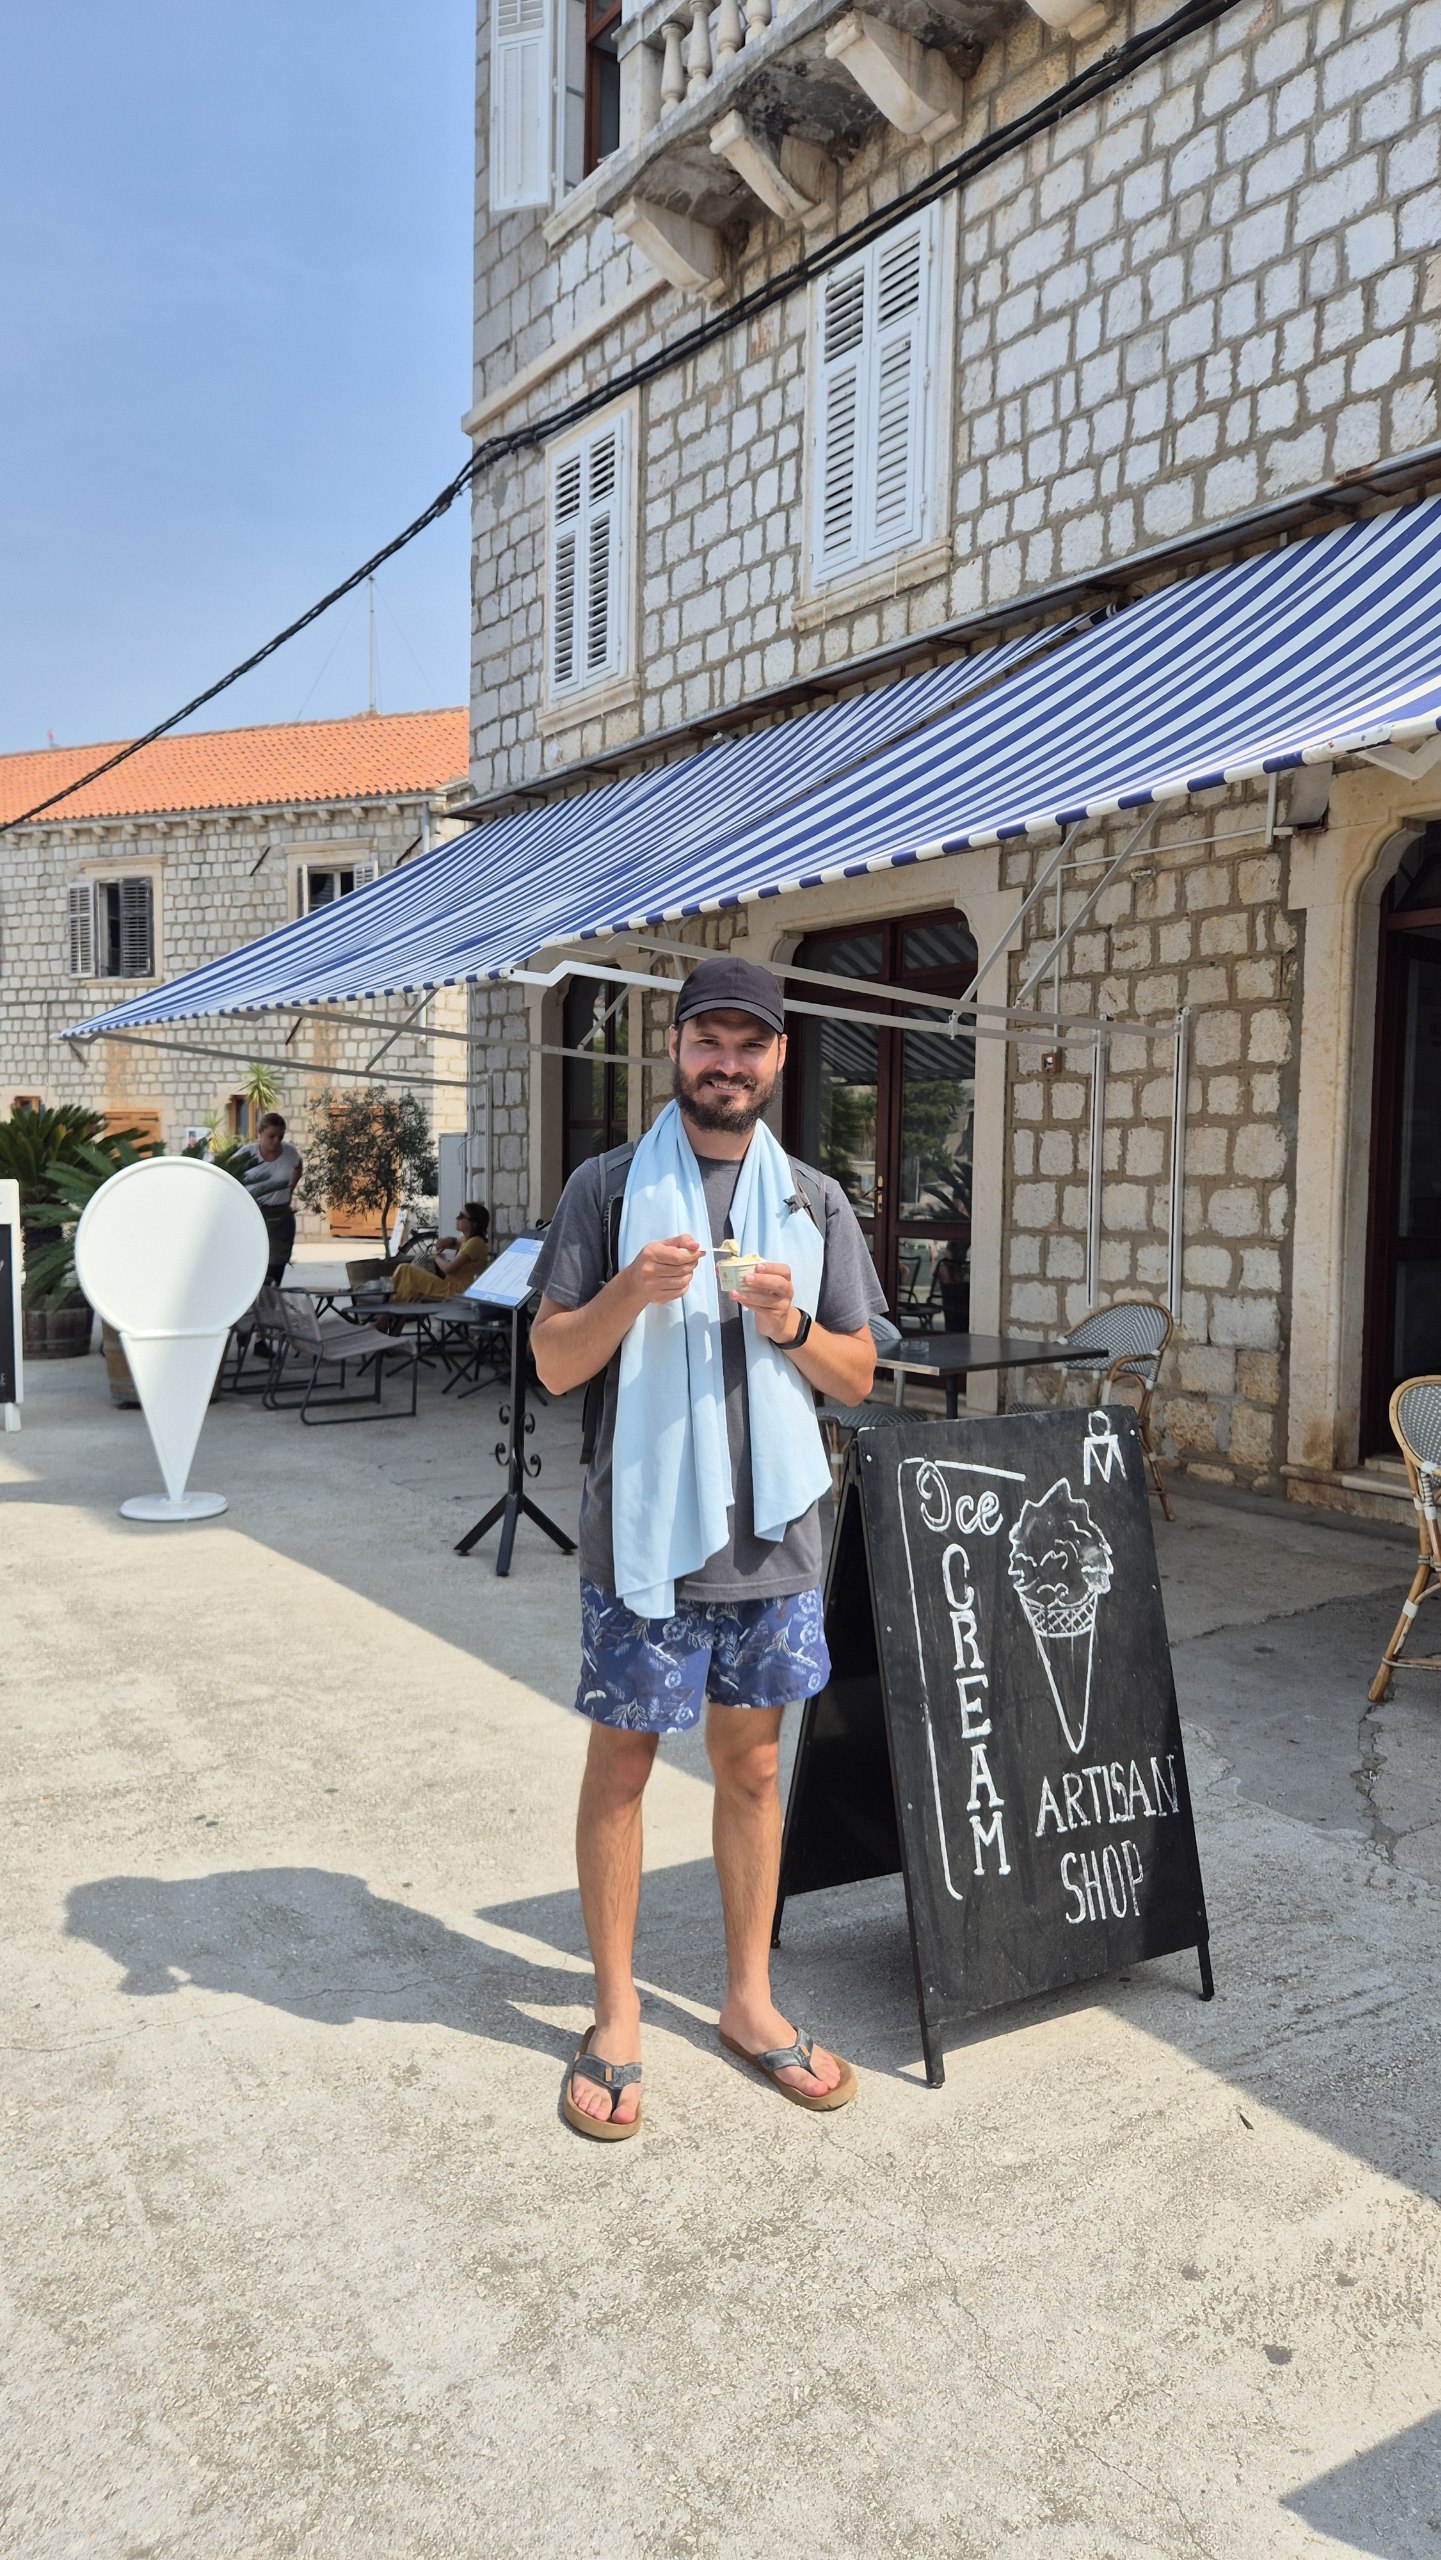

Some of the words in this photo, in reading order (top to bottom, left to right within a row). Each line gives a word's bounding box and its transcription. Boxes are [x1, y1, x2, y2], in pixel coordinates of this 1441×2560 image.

[916, 1461, 1003, 1535] Ice
[941, 1543, 1011, 1877] CREAM
[1035, 1754, 1180, 1838] ARTISAN
[1060, 1839, 1144, 1924] SHOP
